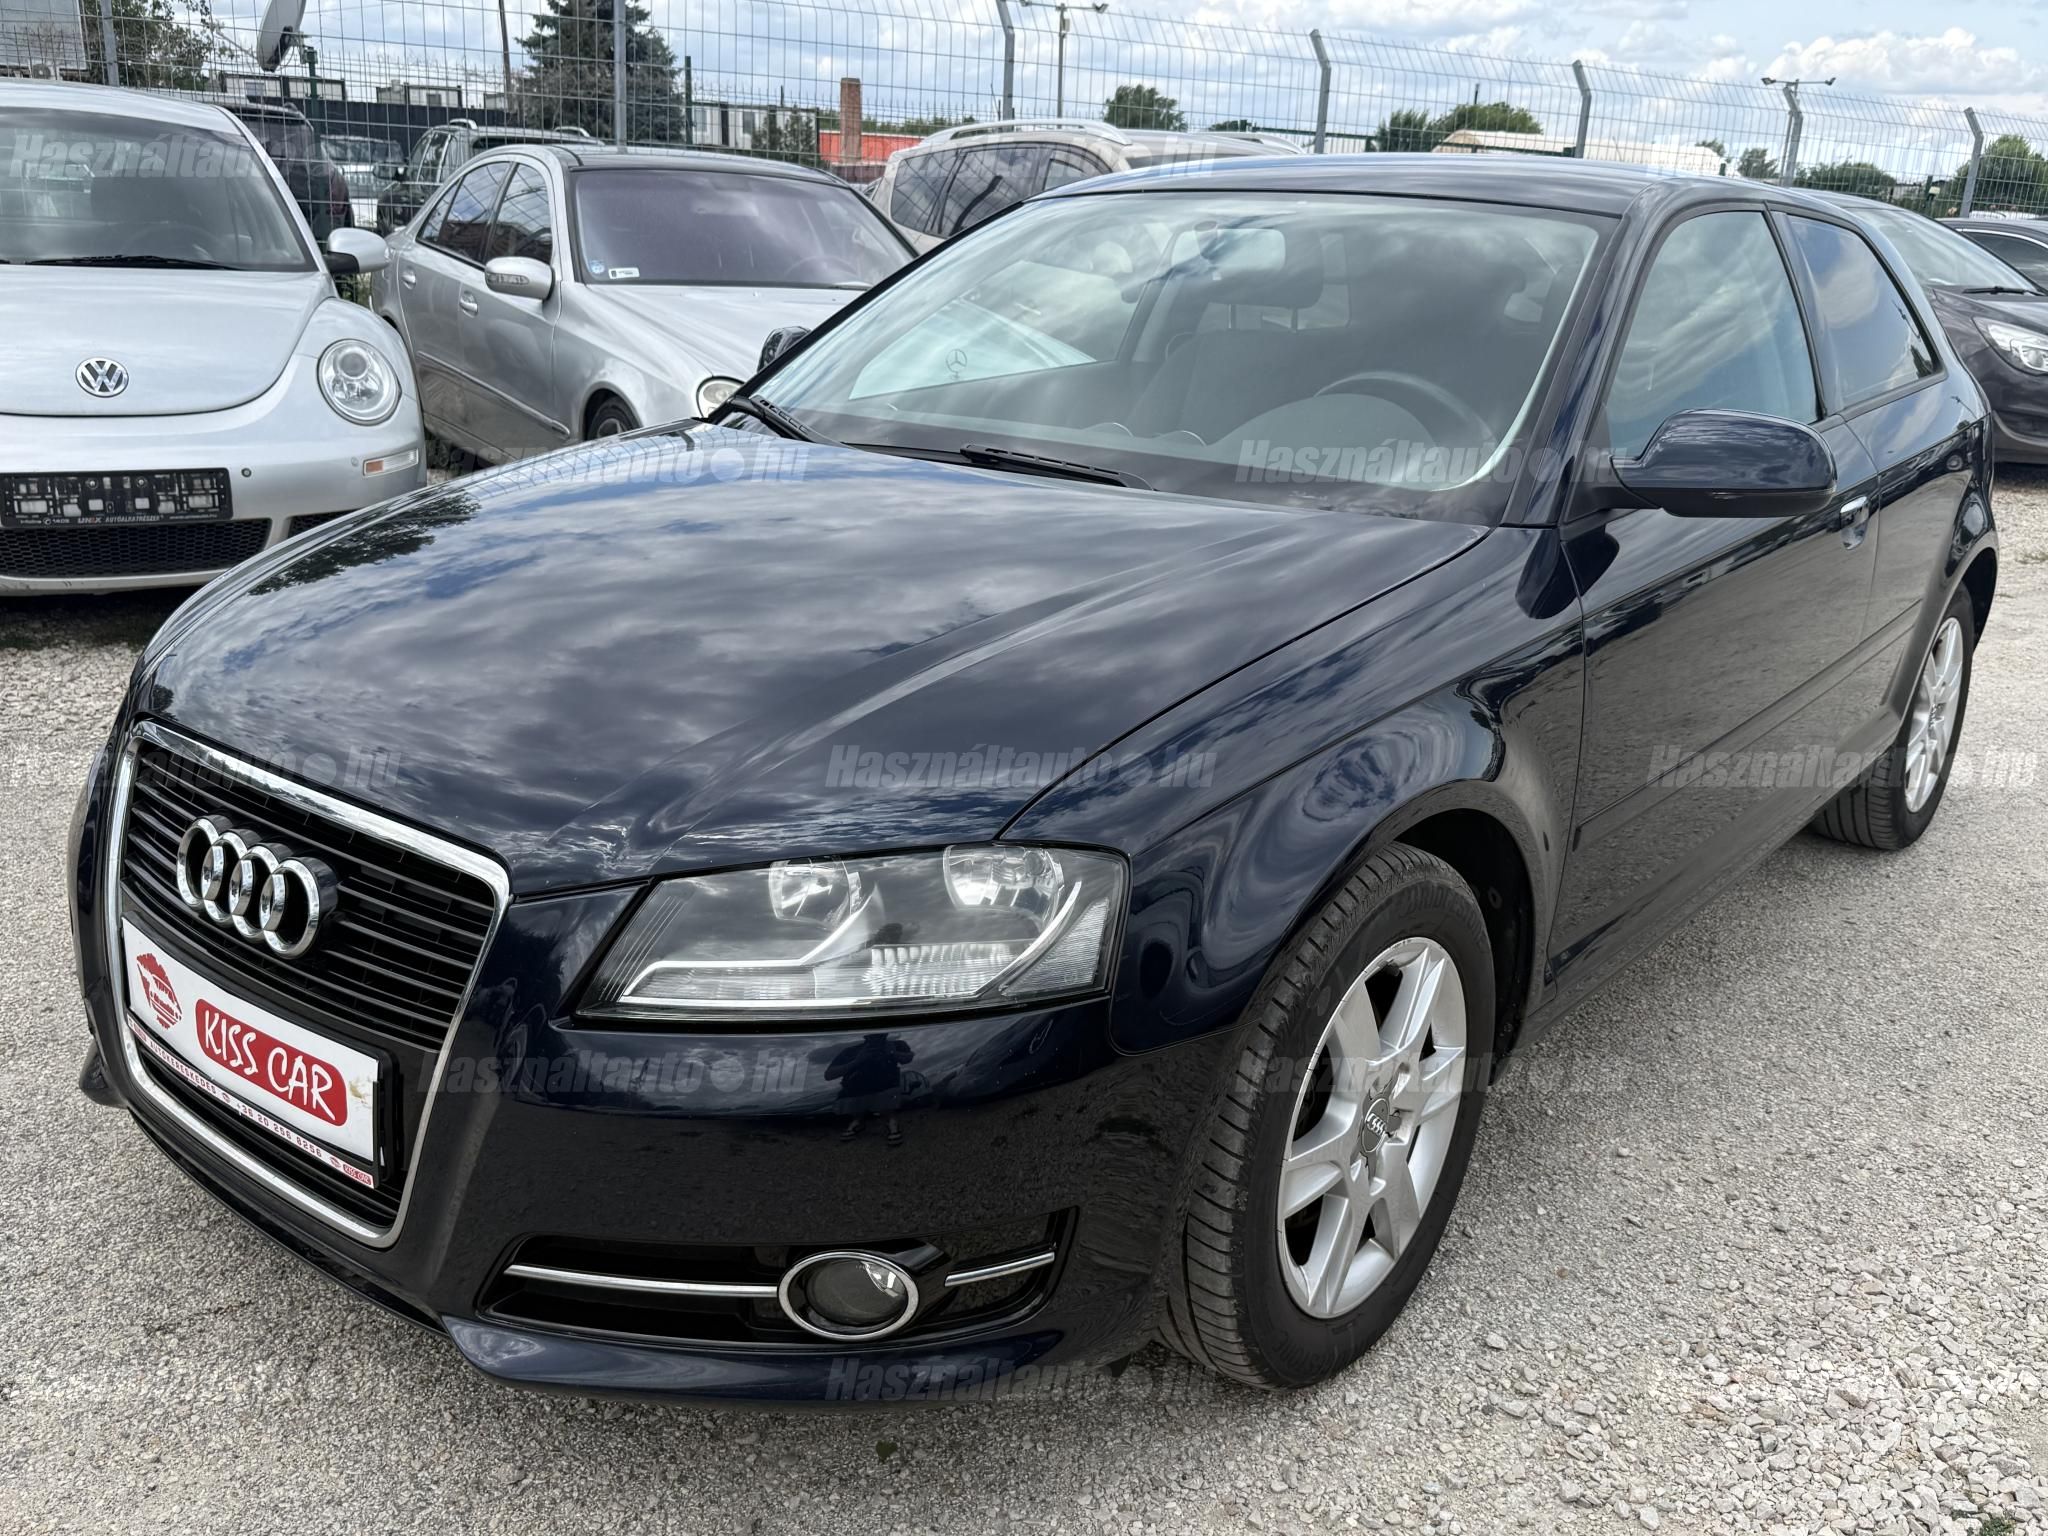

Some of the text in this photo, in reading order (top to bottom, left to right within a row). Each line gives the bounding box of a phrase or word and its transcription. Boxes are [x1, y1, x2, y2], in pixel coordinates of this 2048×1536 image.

[204, 1009, 336, 1121] KISS CAR
[236, 1103, 254, 1118] +36
[257, 1113, 270, 1128] 20
[273, 1122, 292, 1141] 256
